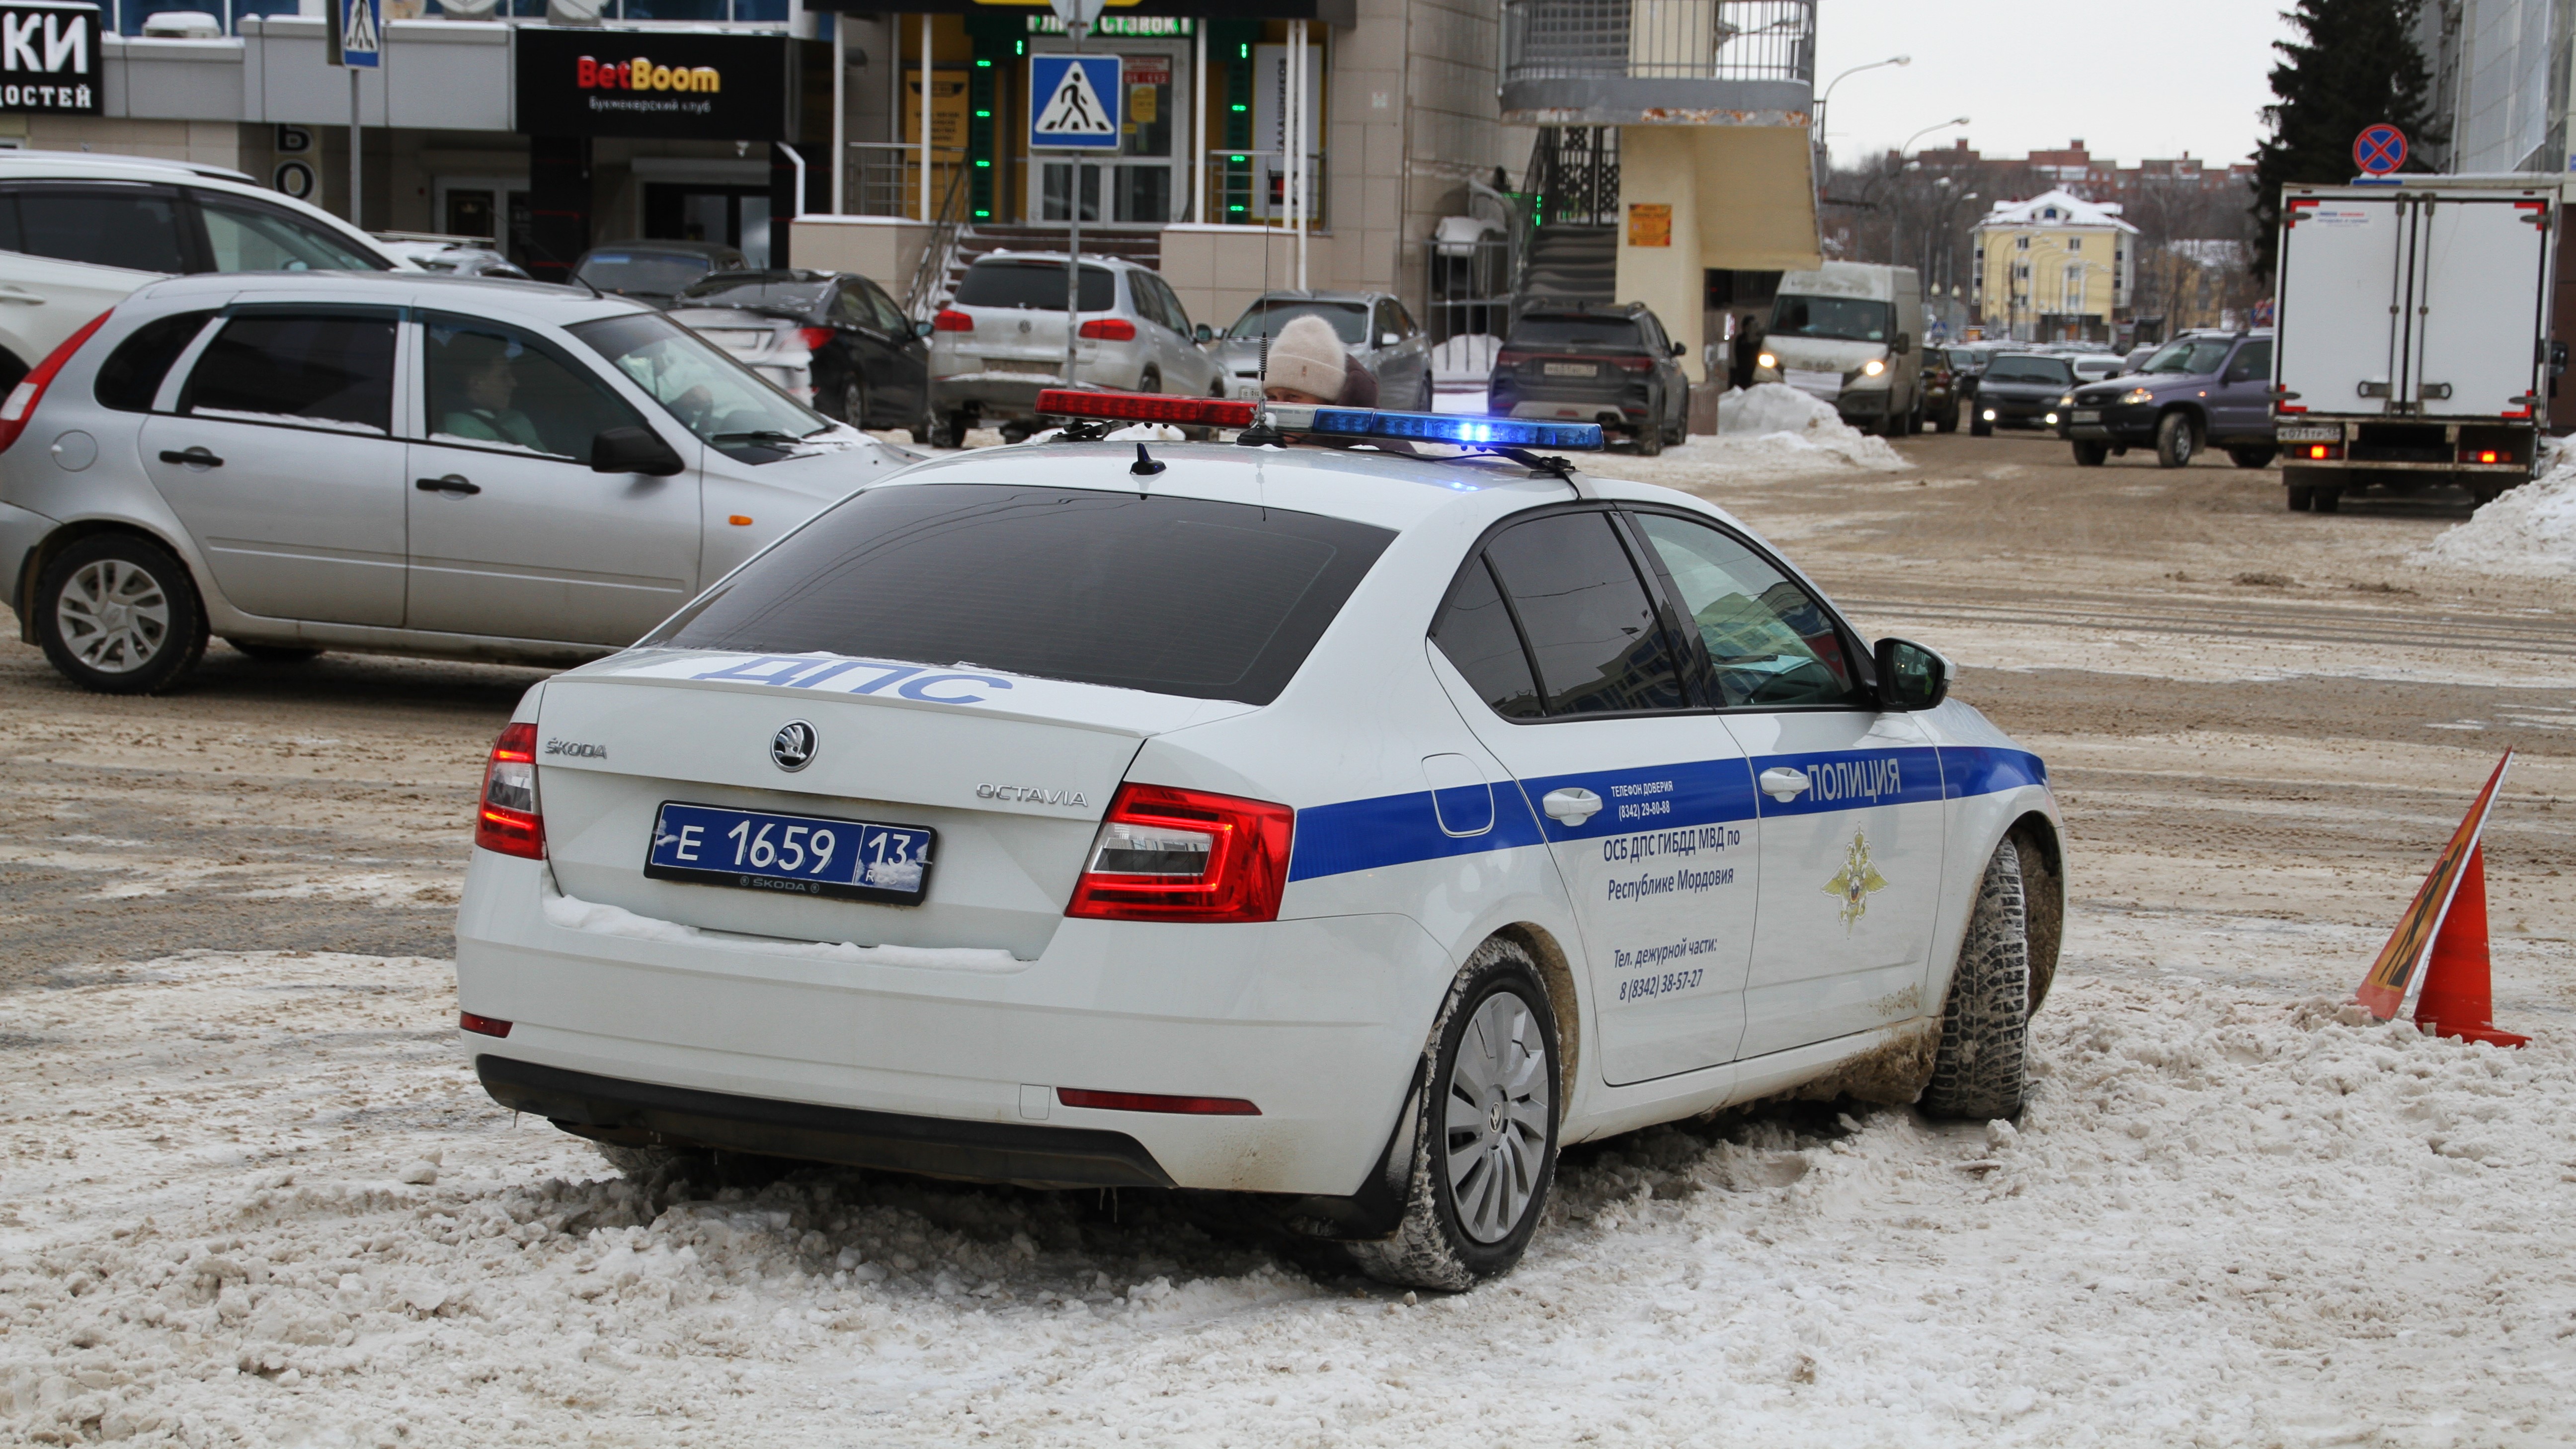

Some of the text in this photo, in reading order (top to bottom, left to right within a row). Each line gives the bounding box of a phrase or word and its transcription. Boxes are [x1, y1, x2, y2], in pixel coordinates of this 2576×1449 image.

[577, 55, 721, 93] BetBoom
[0, 83, 92, 108] ОСТЕЙ
[589, 96, 711, 115] Букмекерский клуб
[688, 656, 1013, 704] ДПС
[976, 783, 1088, 807] OCTAVIA
[1611, 781, 1673, 797] ТЕЛЕФОН ДОВЕРИЯ
[1807, 758, 1901, 804] ПОЛИЦИЯ
[1619, 801, 1670, 821] (8342) 29-80-88
[728, 819, 835, 874] 1659
[869, 832, 911, 868] 13
[1604, 826, 1740, 864] ОСБ ДПС ГИБДД МВД по
[752, 877, 806, 892] ŠKODA
[1608, 868, 1734, 902] Республике Мордовия
[1614, 937, 1718, 969] Тел. дежурной части:
[1619, 968, 1703, 1003] 8 (8342) 38-57-27
